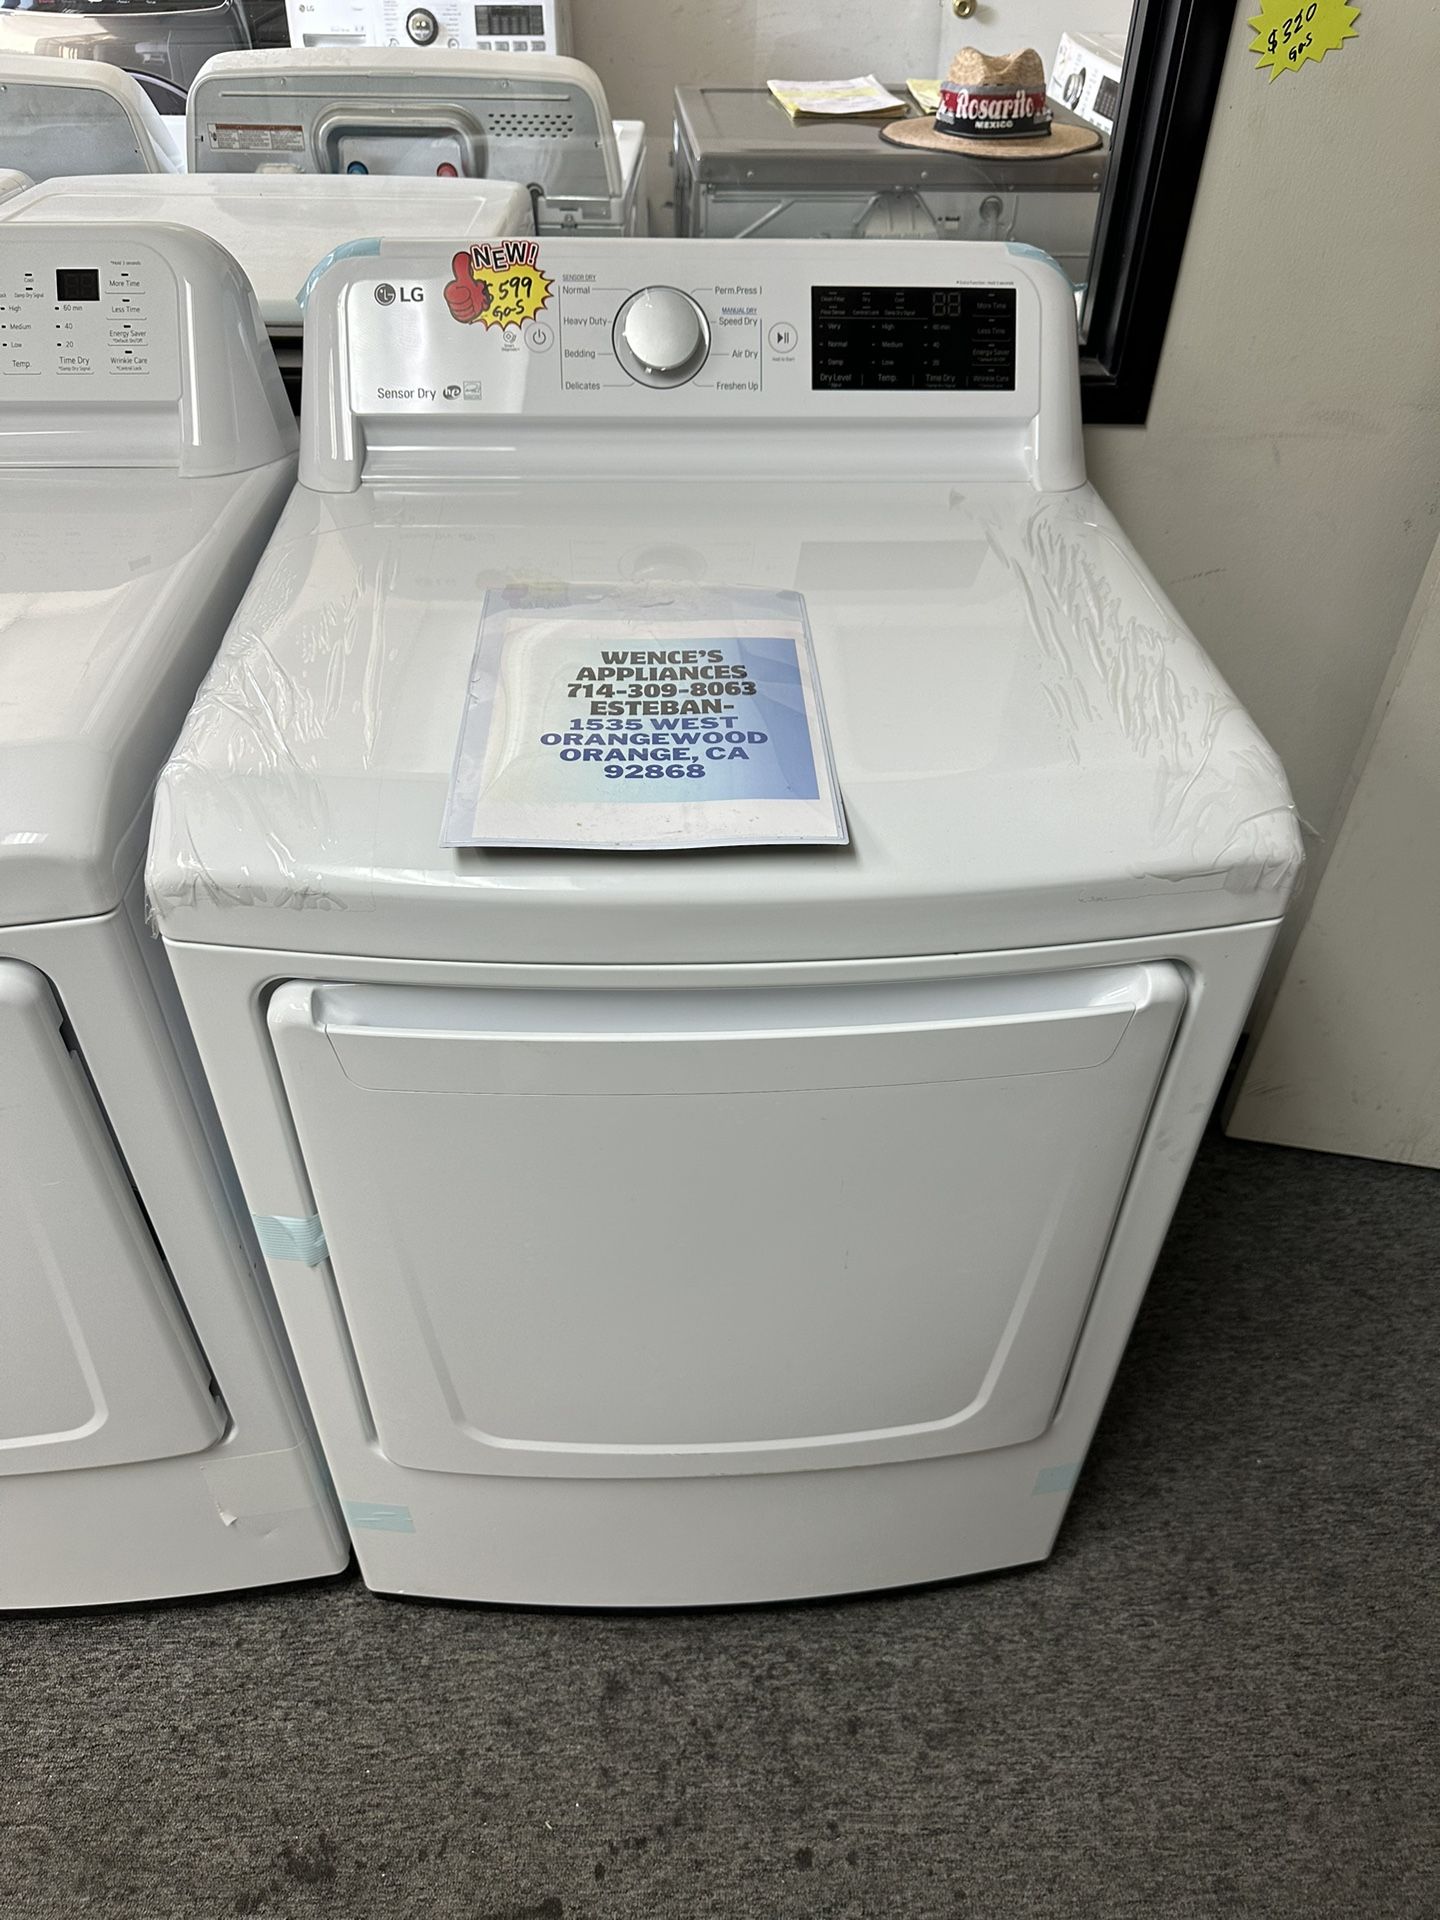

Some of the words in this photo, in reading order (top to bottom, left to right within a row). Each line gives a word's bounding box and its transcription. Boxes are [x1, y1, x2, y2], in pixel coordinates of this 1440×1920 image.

[1268, 3, 1317, 54] $320
[955, 88, 1034, 120] Rosarito
[975, 120, 1013, 129] MEXICO
[473, 242, 537, 270] NEW!
[400, 287, 424, 302] LG
[562, 286, 591, 295] Normal
[65, 323, 73, 331] 40
[563, 318, 587, 328] Heavy
[589, 318, 608, 328] Duty
[719, 317, 743, 328] Speed
[744, 317, 758, 328] Dry
[66, 341, 74, 349] 20
[59, 356, 76, 365] Time
[77, 356, 90, 366] Dry
[564, 349, 596, 360] Bedding
[732, 349, 743, 359] Air
[744, 349, 758, 361] Dry
[565, 382, 601, 391] Delicates
[716, 382, 746, 391] Freshen
[747, 382, 759, 392] Up
[378, 388, 414, 400] Sensor
[418, 388, 437, 402] Dry
[601, 650, 723, 664] WENCE'S
[576, 665, 747, 681] APPLIANCES
[567, 682, 756, 698] 714-309-8063
[590, 699, 735, 716] ESTEBAN-
[570, 718, 643, 731] 1535
[650, 717, 738, 730] WEST
[540, 731, 769, 746] ORANGEWOOD
[560, 747, 698, 763] ORANGE,
[707, 746, 750, 760] CA
[604, 764, 706, 779] 92868
